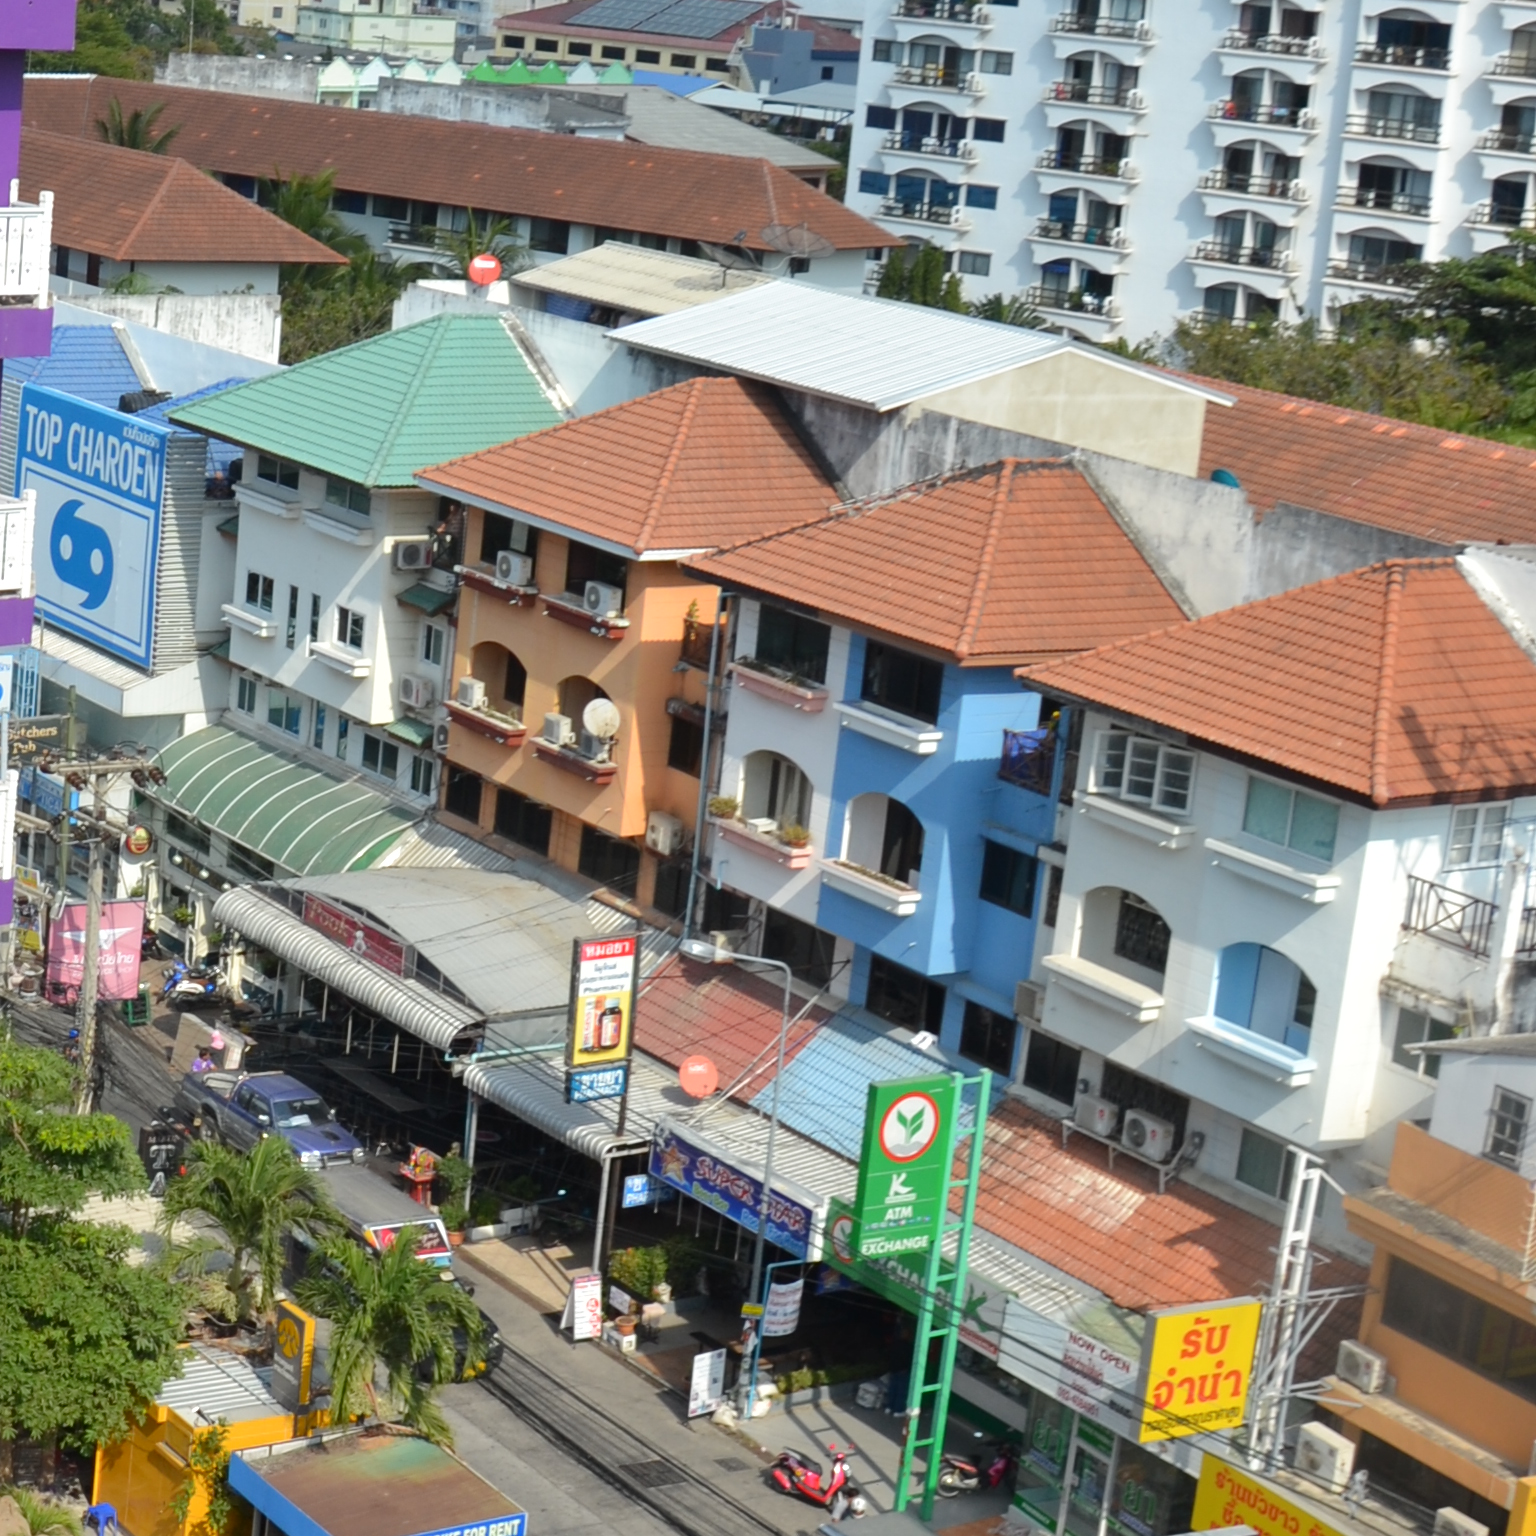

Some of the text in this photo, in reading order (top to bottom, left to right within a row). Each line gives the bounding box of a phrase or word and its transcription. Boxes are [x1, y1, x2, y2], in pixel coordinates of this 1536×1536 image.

[25, 403, 160, 503] TOP CHAROEN
[884, 1206, 914, 1221] ATM
[861, 1234, 929, 1255] EXCHANGE
[1068, 1331, 1096, 1354] NOW
[1100, 1349, 1131, 1374] OPEN
[1180, 1317, 1231, 1359] รับ
[1152, 1360, 1242, 1411] จำนำ
